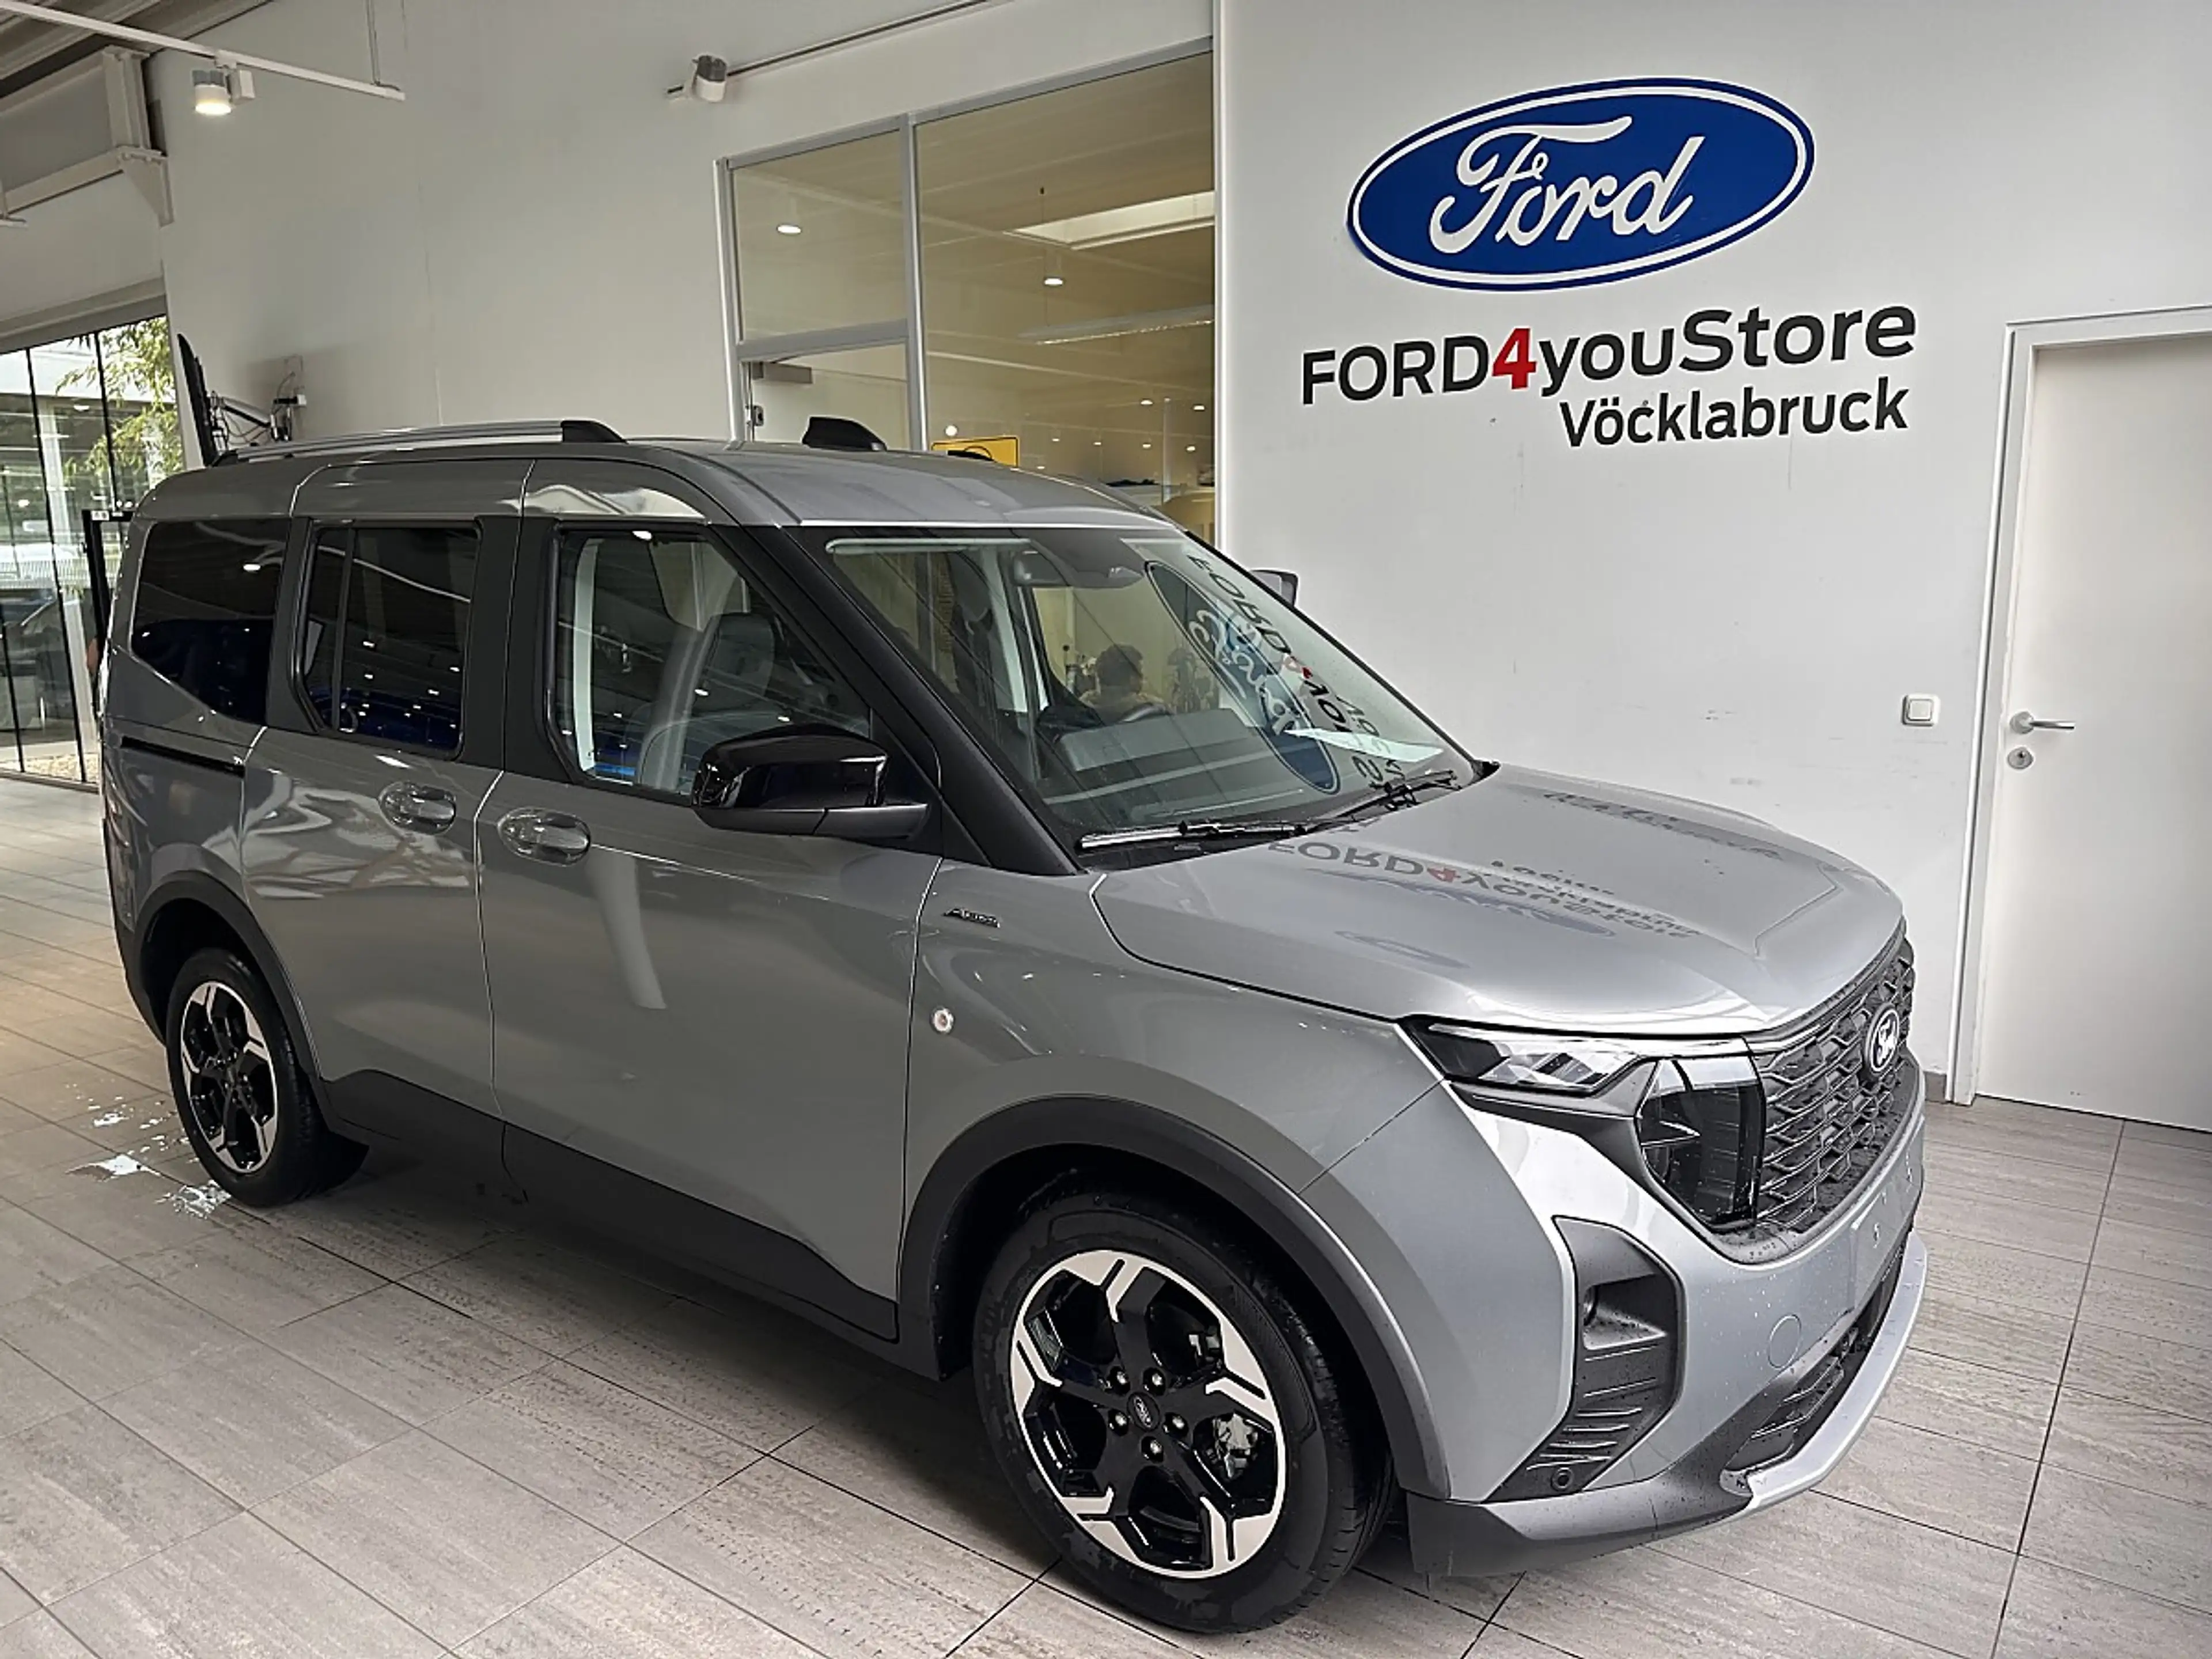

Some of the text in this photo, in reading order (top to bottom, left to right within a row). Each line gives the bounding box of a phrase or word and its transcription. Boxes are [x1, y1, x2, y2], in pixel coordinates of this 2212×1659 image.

[1429, 116, 1705, 253] Ford
[1303, 304, 1916, 405] FORD4youStore
[1559, 377, 1910, 448] Vöcklabruck
